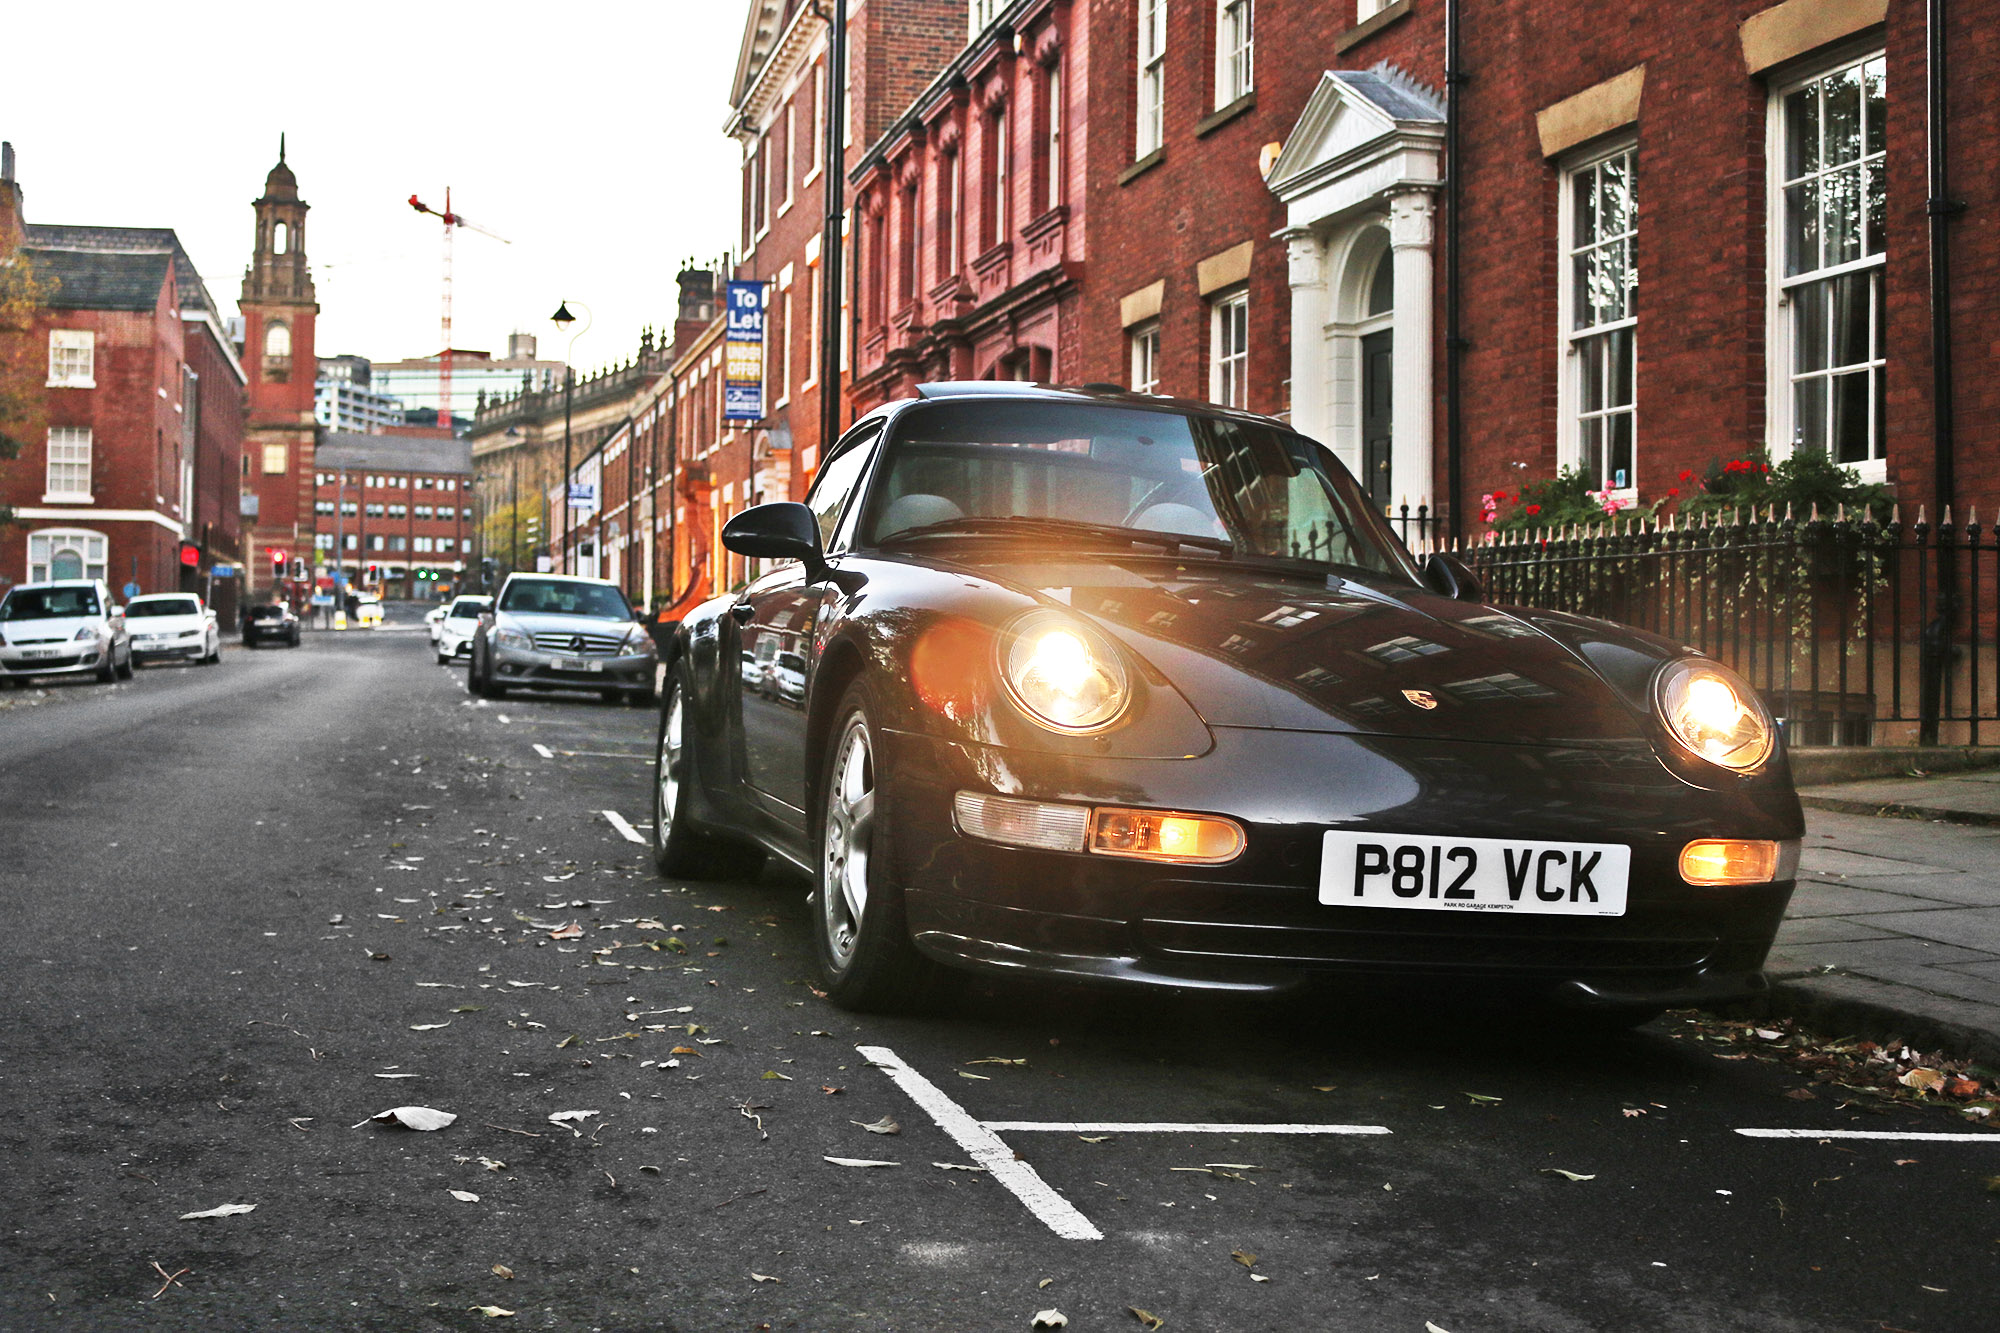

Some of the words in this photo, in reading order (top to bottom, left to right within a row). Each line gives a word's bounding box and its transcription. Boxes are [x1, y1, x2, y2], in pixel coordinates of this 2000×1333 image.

[732, 288, 758, 308] To
[729, 310, 762, 330] Let
[728, 346, 762, 361] UNDER
[728, 361, 761, 376] OFFER
[1354, 843, 1477, 900] P812
[1503, 848, 1602, 903] VCK
